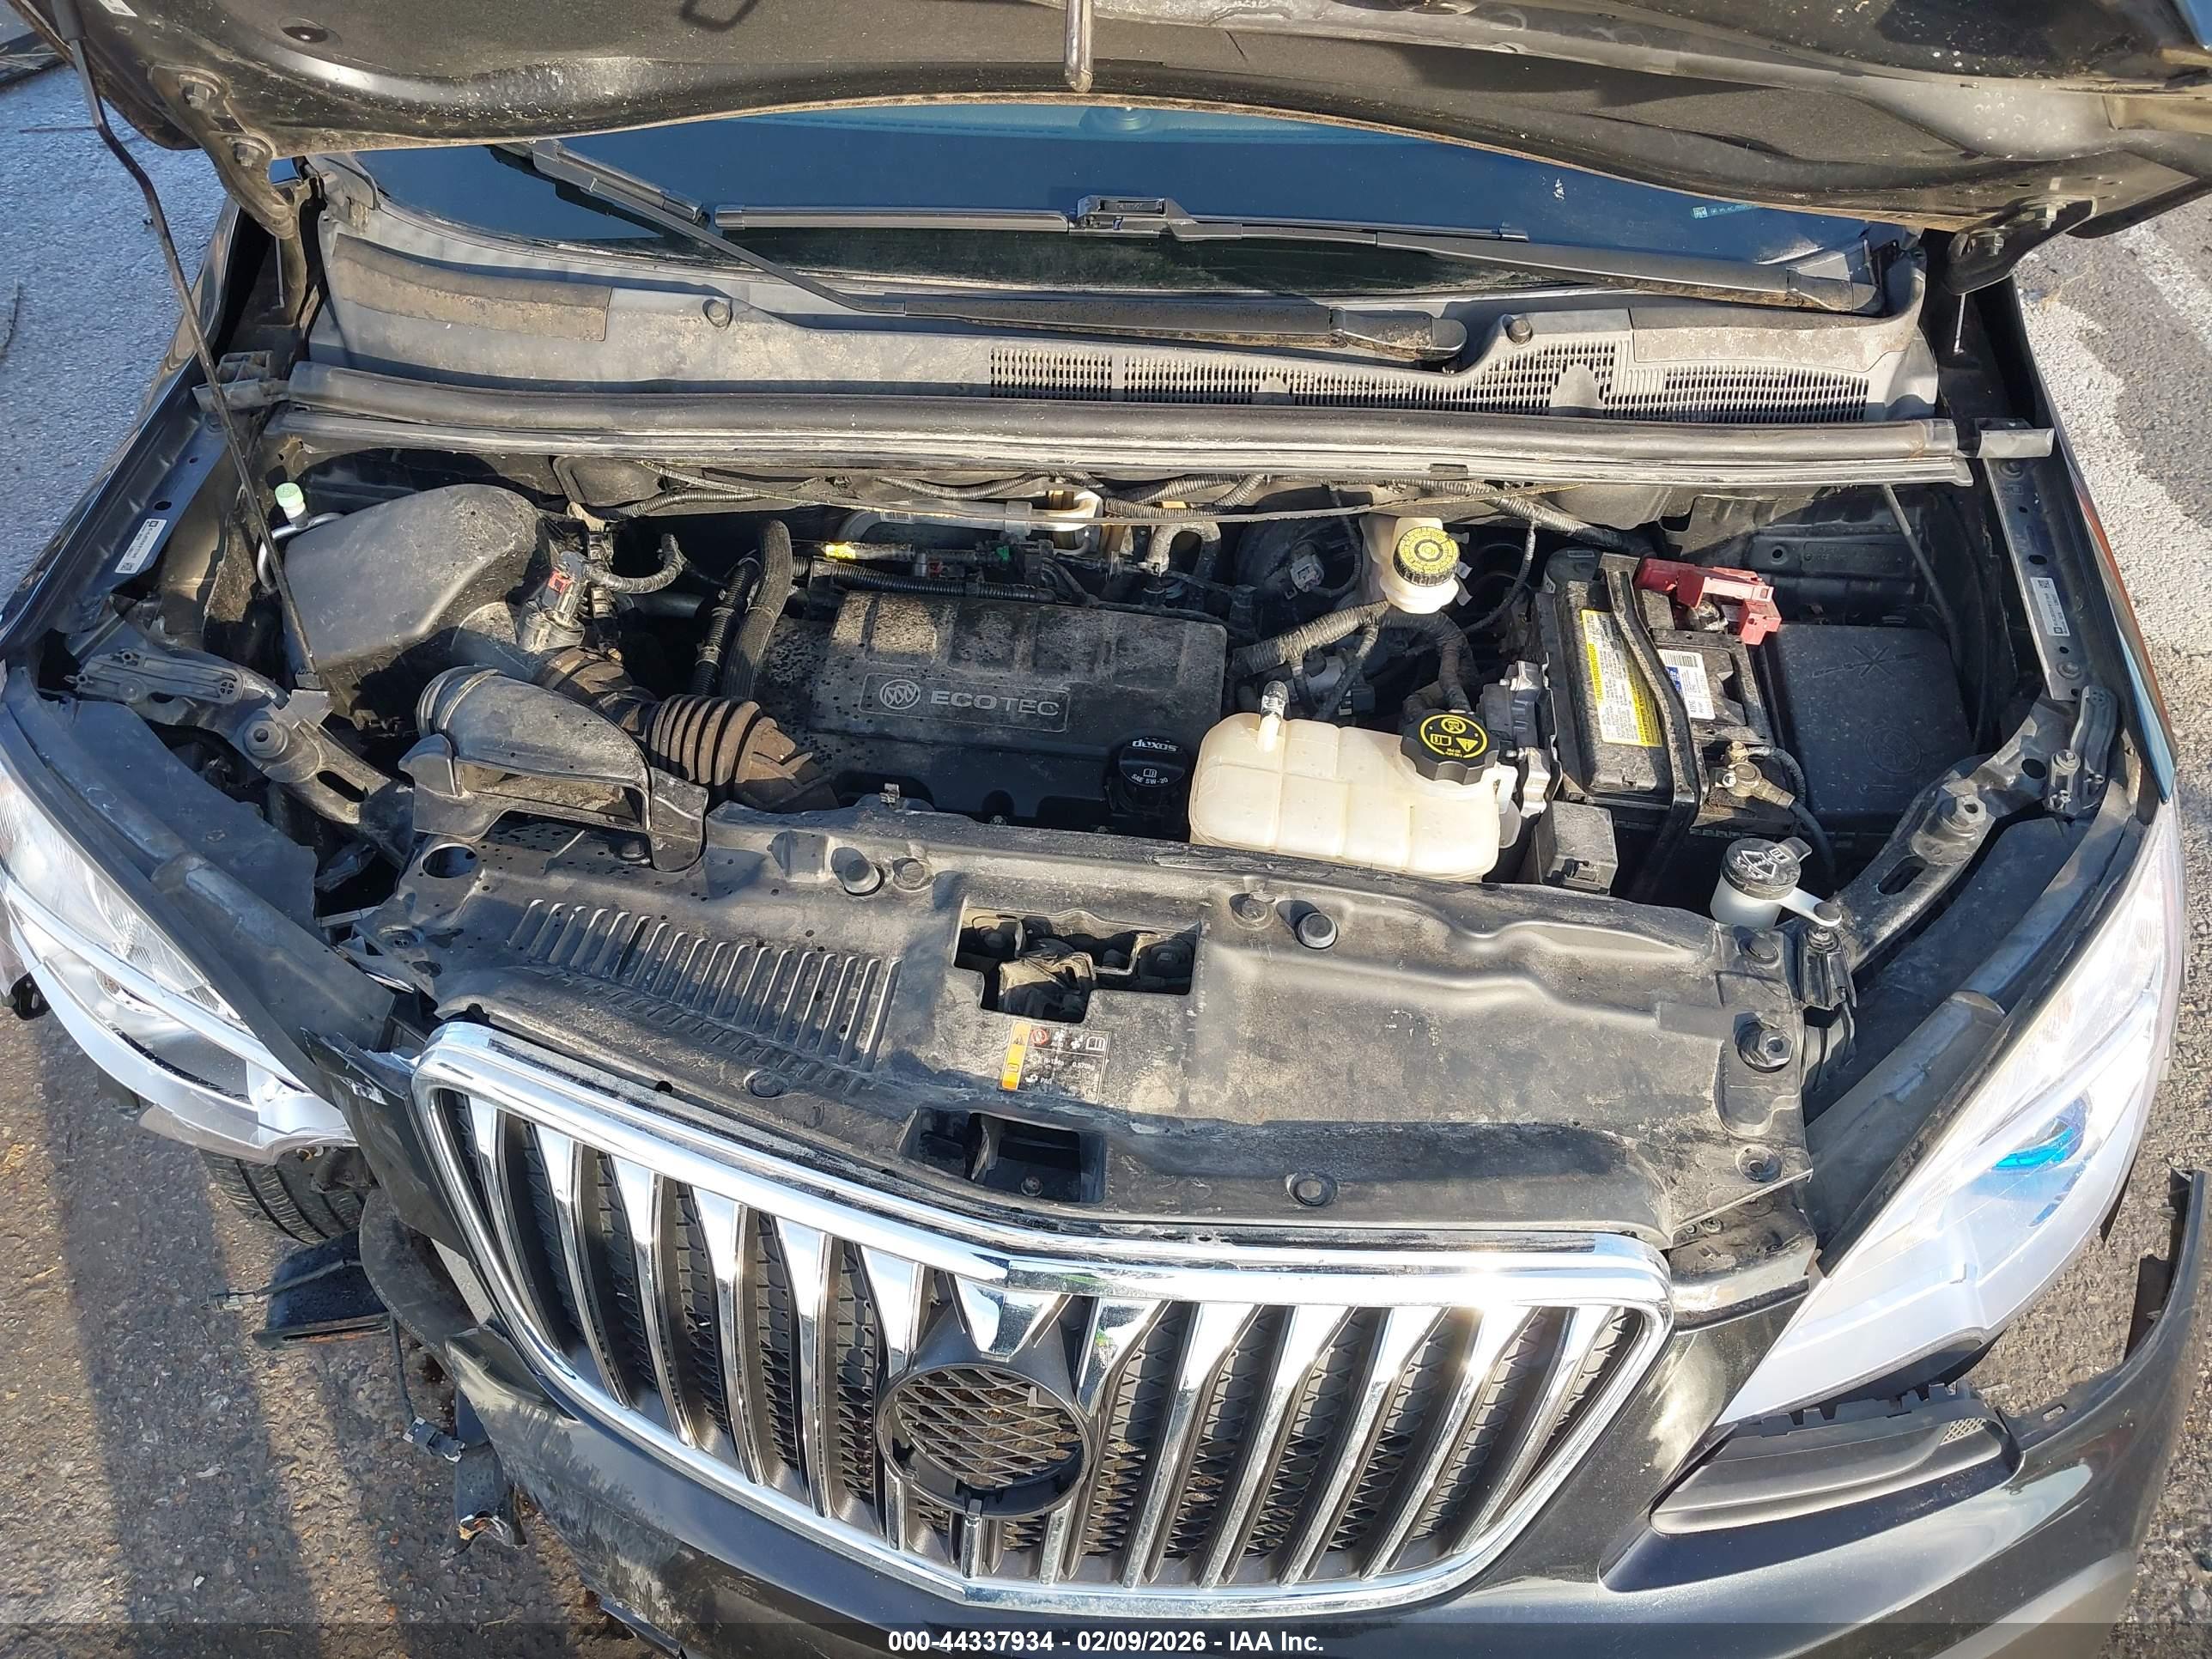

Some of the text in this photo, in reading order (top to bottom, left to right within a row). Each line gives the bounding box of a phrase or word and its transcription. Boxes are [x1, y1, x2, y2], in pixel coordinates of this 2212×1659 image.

[930, 690, 1060, 716] ECOTEC
[1132, 739, 1179, 752] dexos
[1131, 774, 1144, 783] SAE
